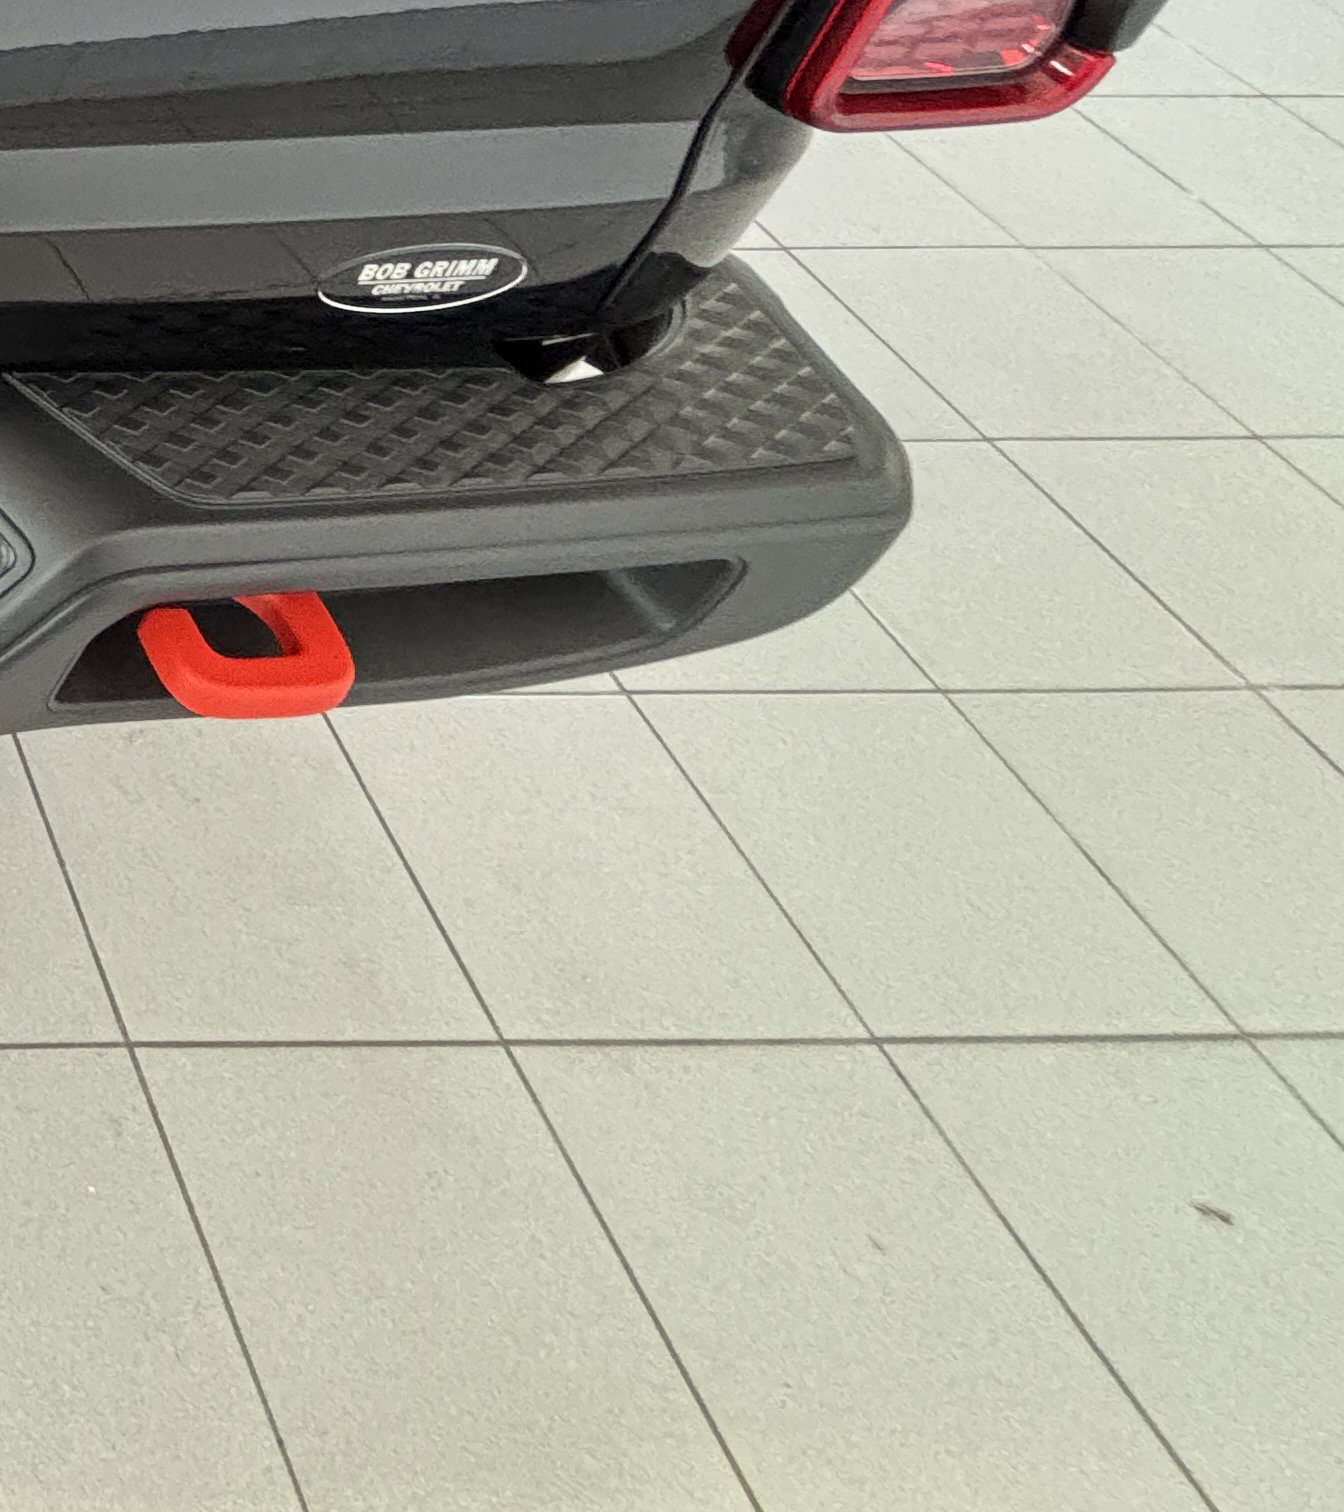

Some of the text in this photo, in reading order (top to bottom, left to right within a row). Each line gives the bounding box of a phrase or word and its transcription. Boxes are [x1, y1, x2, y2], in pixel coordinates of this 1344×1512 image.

[358, 258, 499, 280] BOB GRIMM
[371, 281, 465, 295] CHEVROLET
